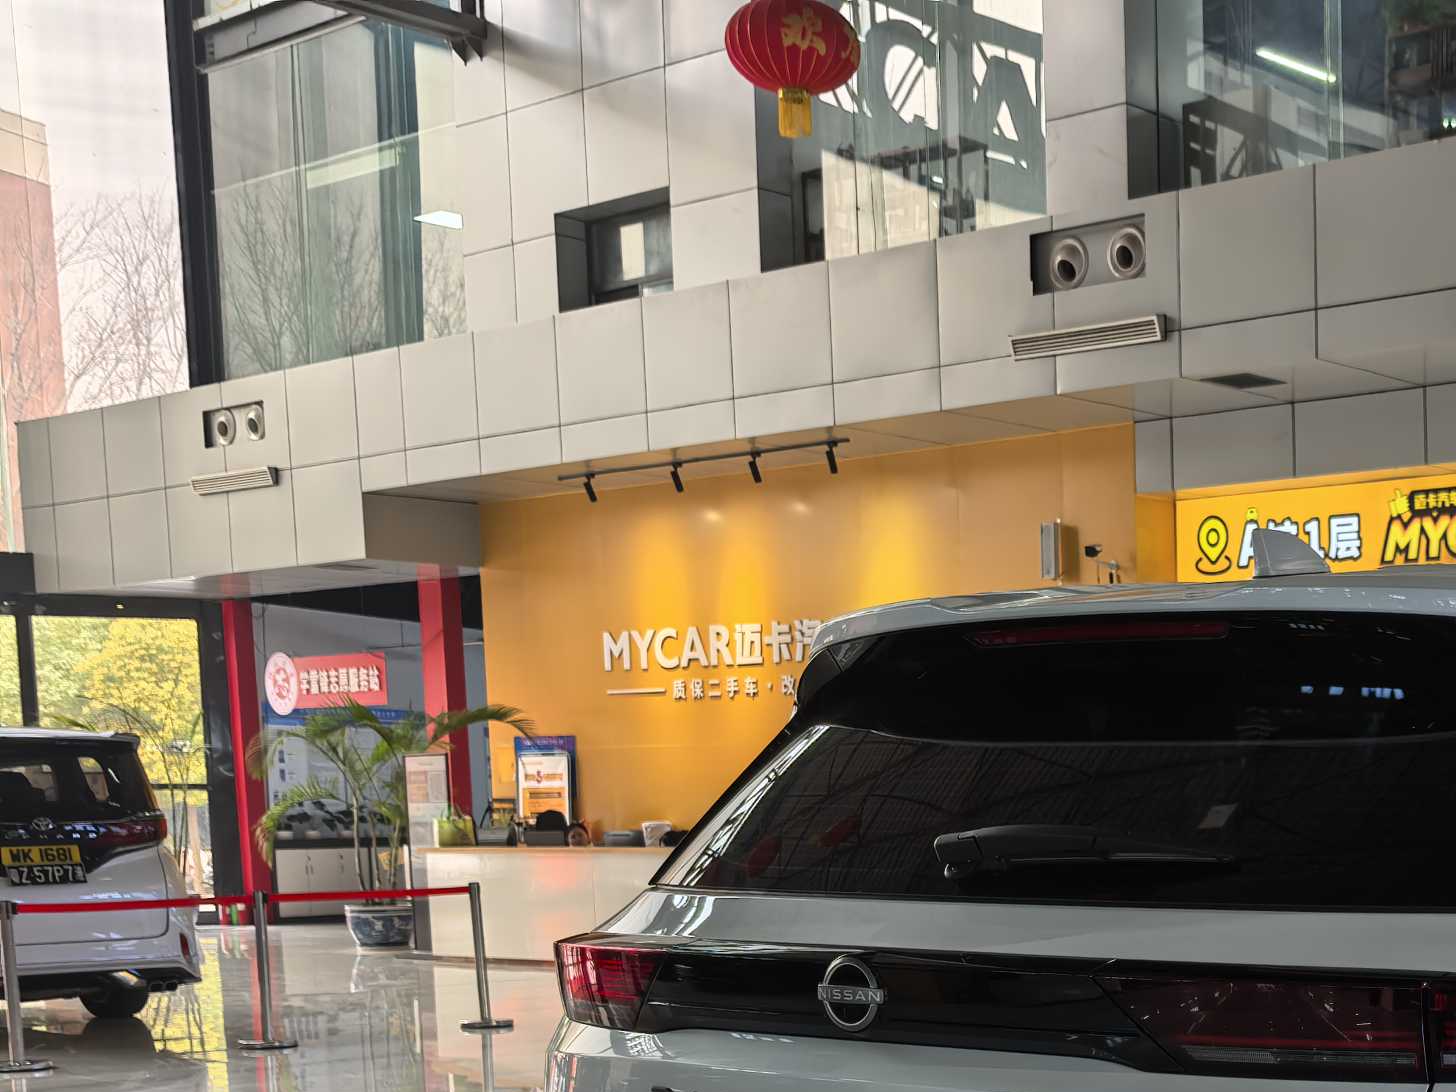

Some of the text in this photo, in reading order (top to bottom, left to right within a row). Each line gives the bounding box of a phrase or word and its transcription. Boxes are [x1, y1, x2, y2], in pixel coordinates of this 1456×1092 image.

[9, 847, 73, 863] WK 1681
[818, 987, 881, 1003] NISSAN
